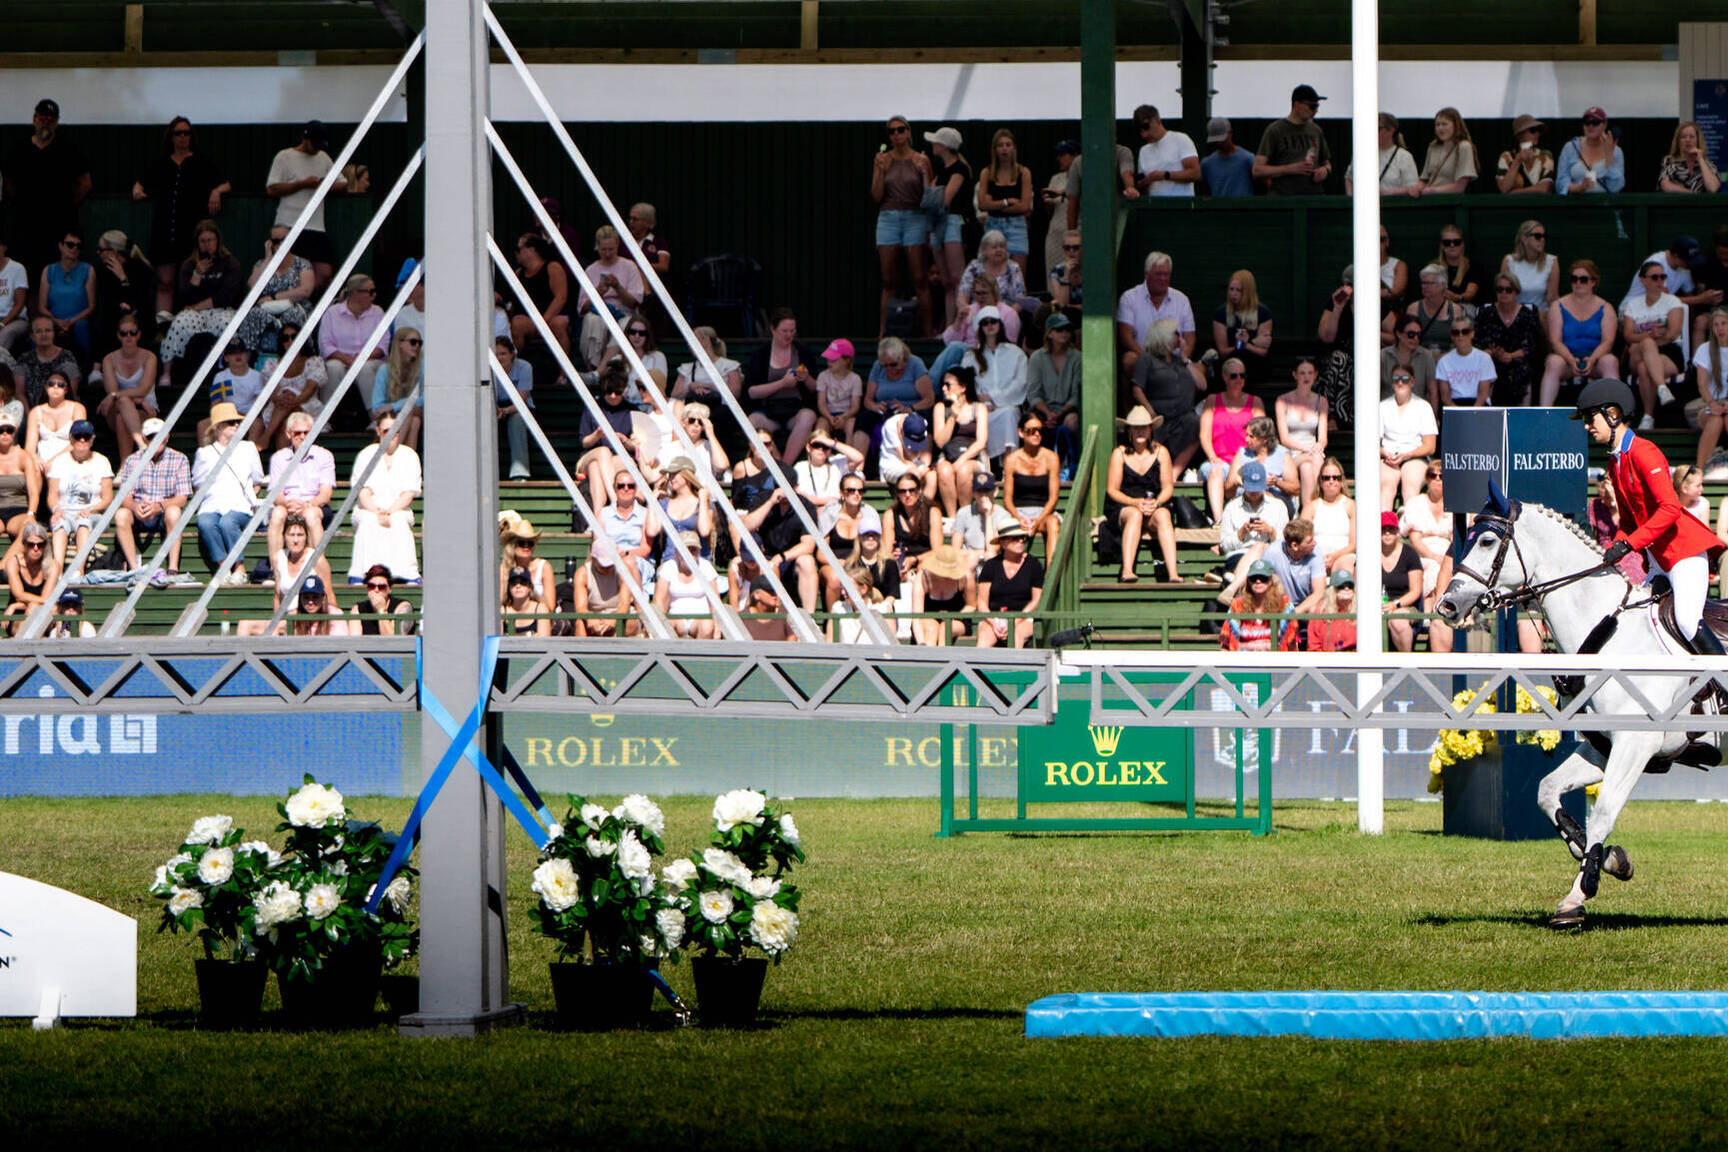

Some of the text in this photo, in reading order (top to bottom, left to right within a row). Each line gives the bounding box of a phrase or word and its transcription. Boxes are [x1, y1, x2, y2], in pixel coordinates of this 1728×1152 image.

[1444, 452, 1500, 471] FALSTERBO
[1513, 452, 1585, 470] FALSTERBO
[0, 684, 102, 755] ria
[524, 736, 681, 768] ROLEX
[884, 737, 1018, 767] ROLE
[1044, 761, 1168, 786] ROLEX
